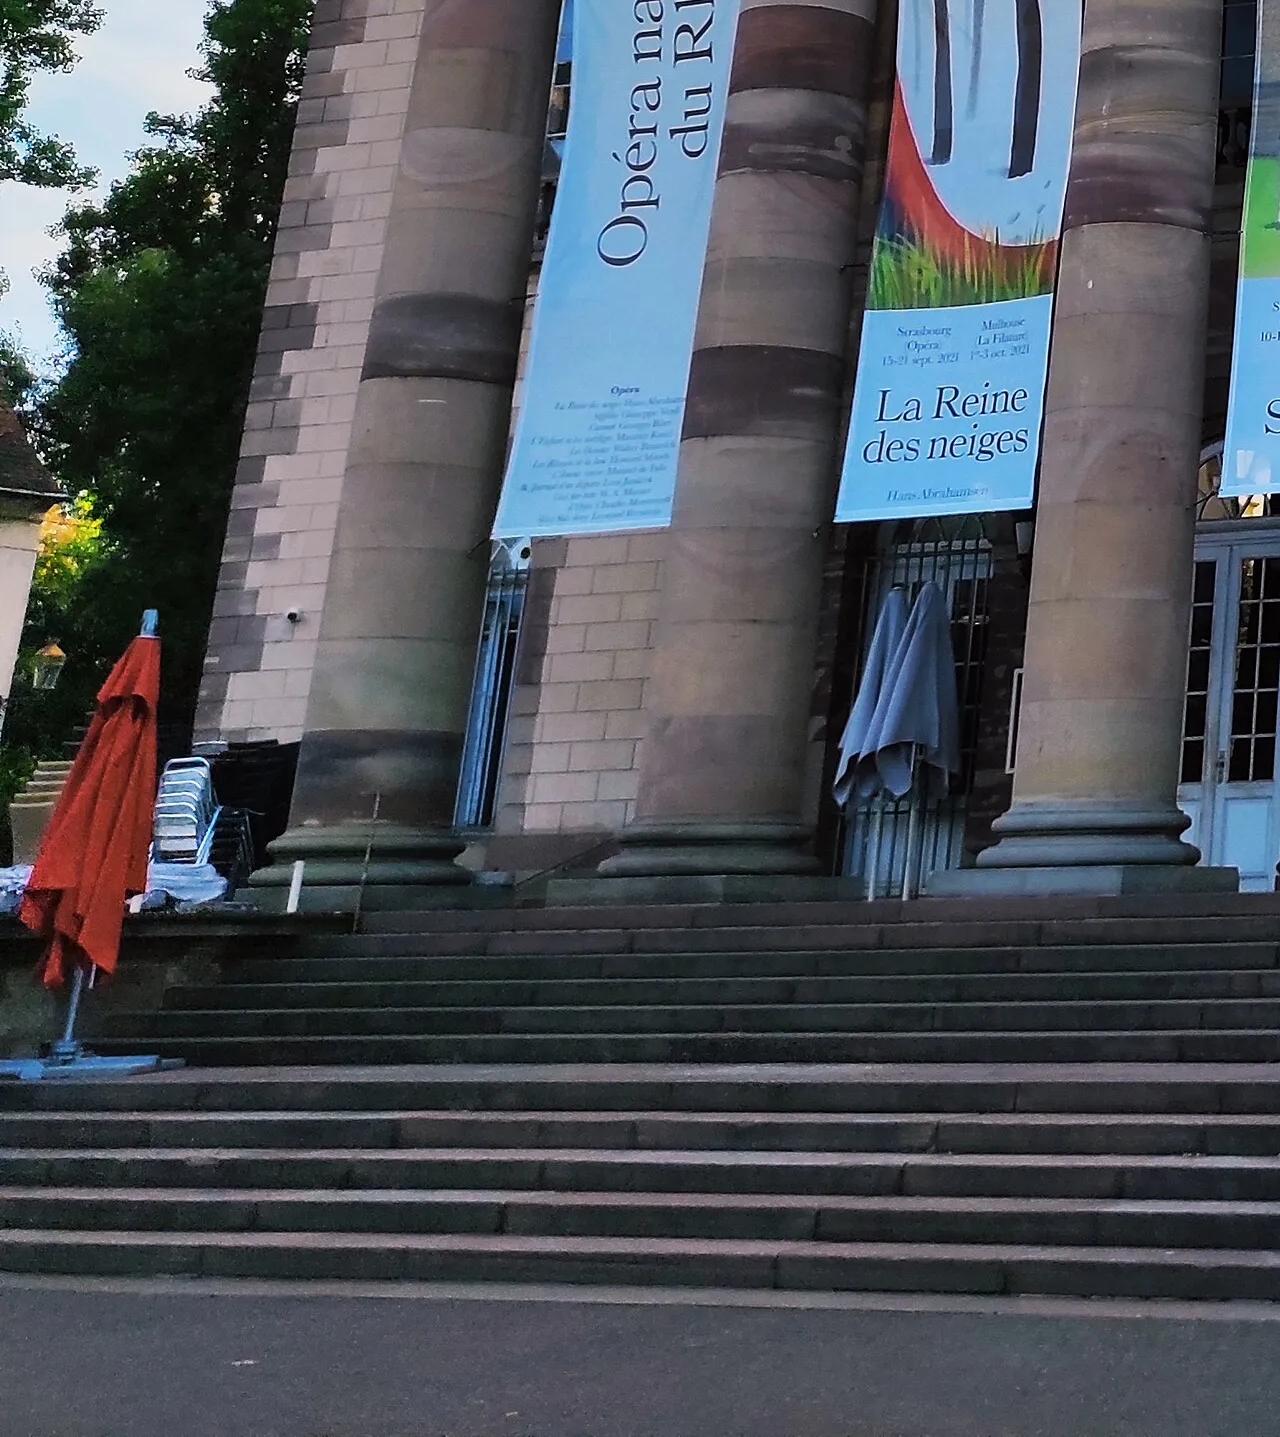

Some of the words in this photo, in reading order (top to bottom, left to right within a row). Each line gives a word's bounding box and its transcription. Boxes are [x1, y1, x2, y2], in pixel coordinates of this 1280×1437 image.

[669, 82, 713, 159] du
[597, 74, 662, 267] Opéra
[896, 325, 952, 337] Strasbourg
[981, 317, 1026, 332] Mulhouse
[1010, 343, 1031, 357] 2021
[937, 352, 960, 364] 2021
[875, 388, 923, 423] La
[931, 382, 1029, 420] Reine
[863, 429, 921, 464] des
[926, 423, 1029, 462] neiges
[887, 490, 916, 502] Hans
